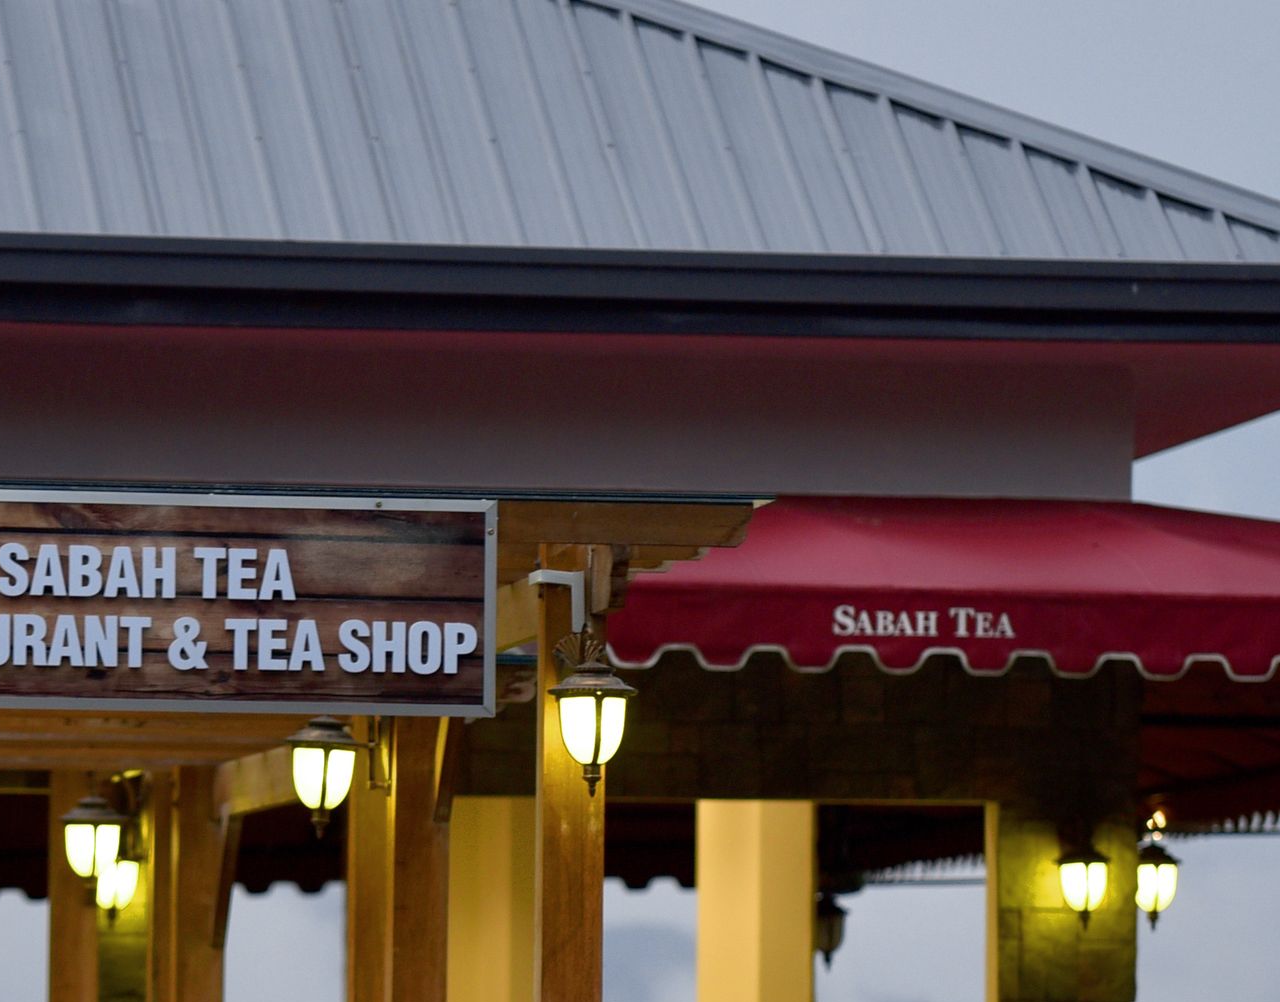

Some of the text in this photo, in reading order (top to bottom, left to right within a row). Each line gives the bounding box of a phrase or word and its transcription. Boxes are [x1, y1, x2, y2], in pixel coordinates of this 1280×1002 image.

[194, 546, 296, 600] TEA
[168, 617, 208, 670] &
[225, 617, 324, 672] TEA
[337, 620, 478, 675] SHOP
[832, 604, 1016, 639] SABAH TEA
